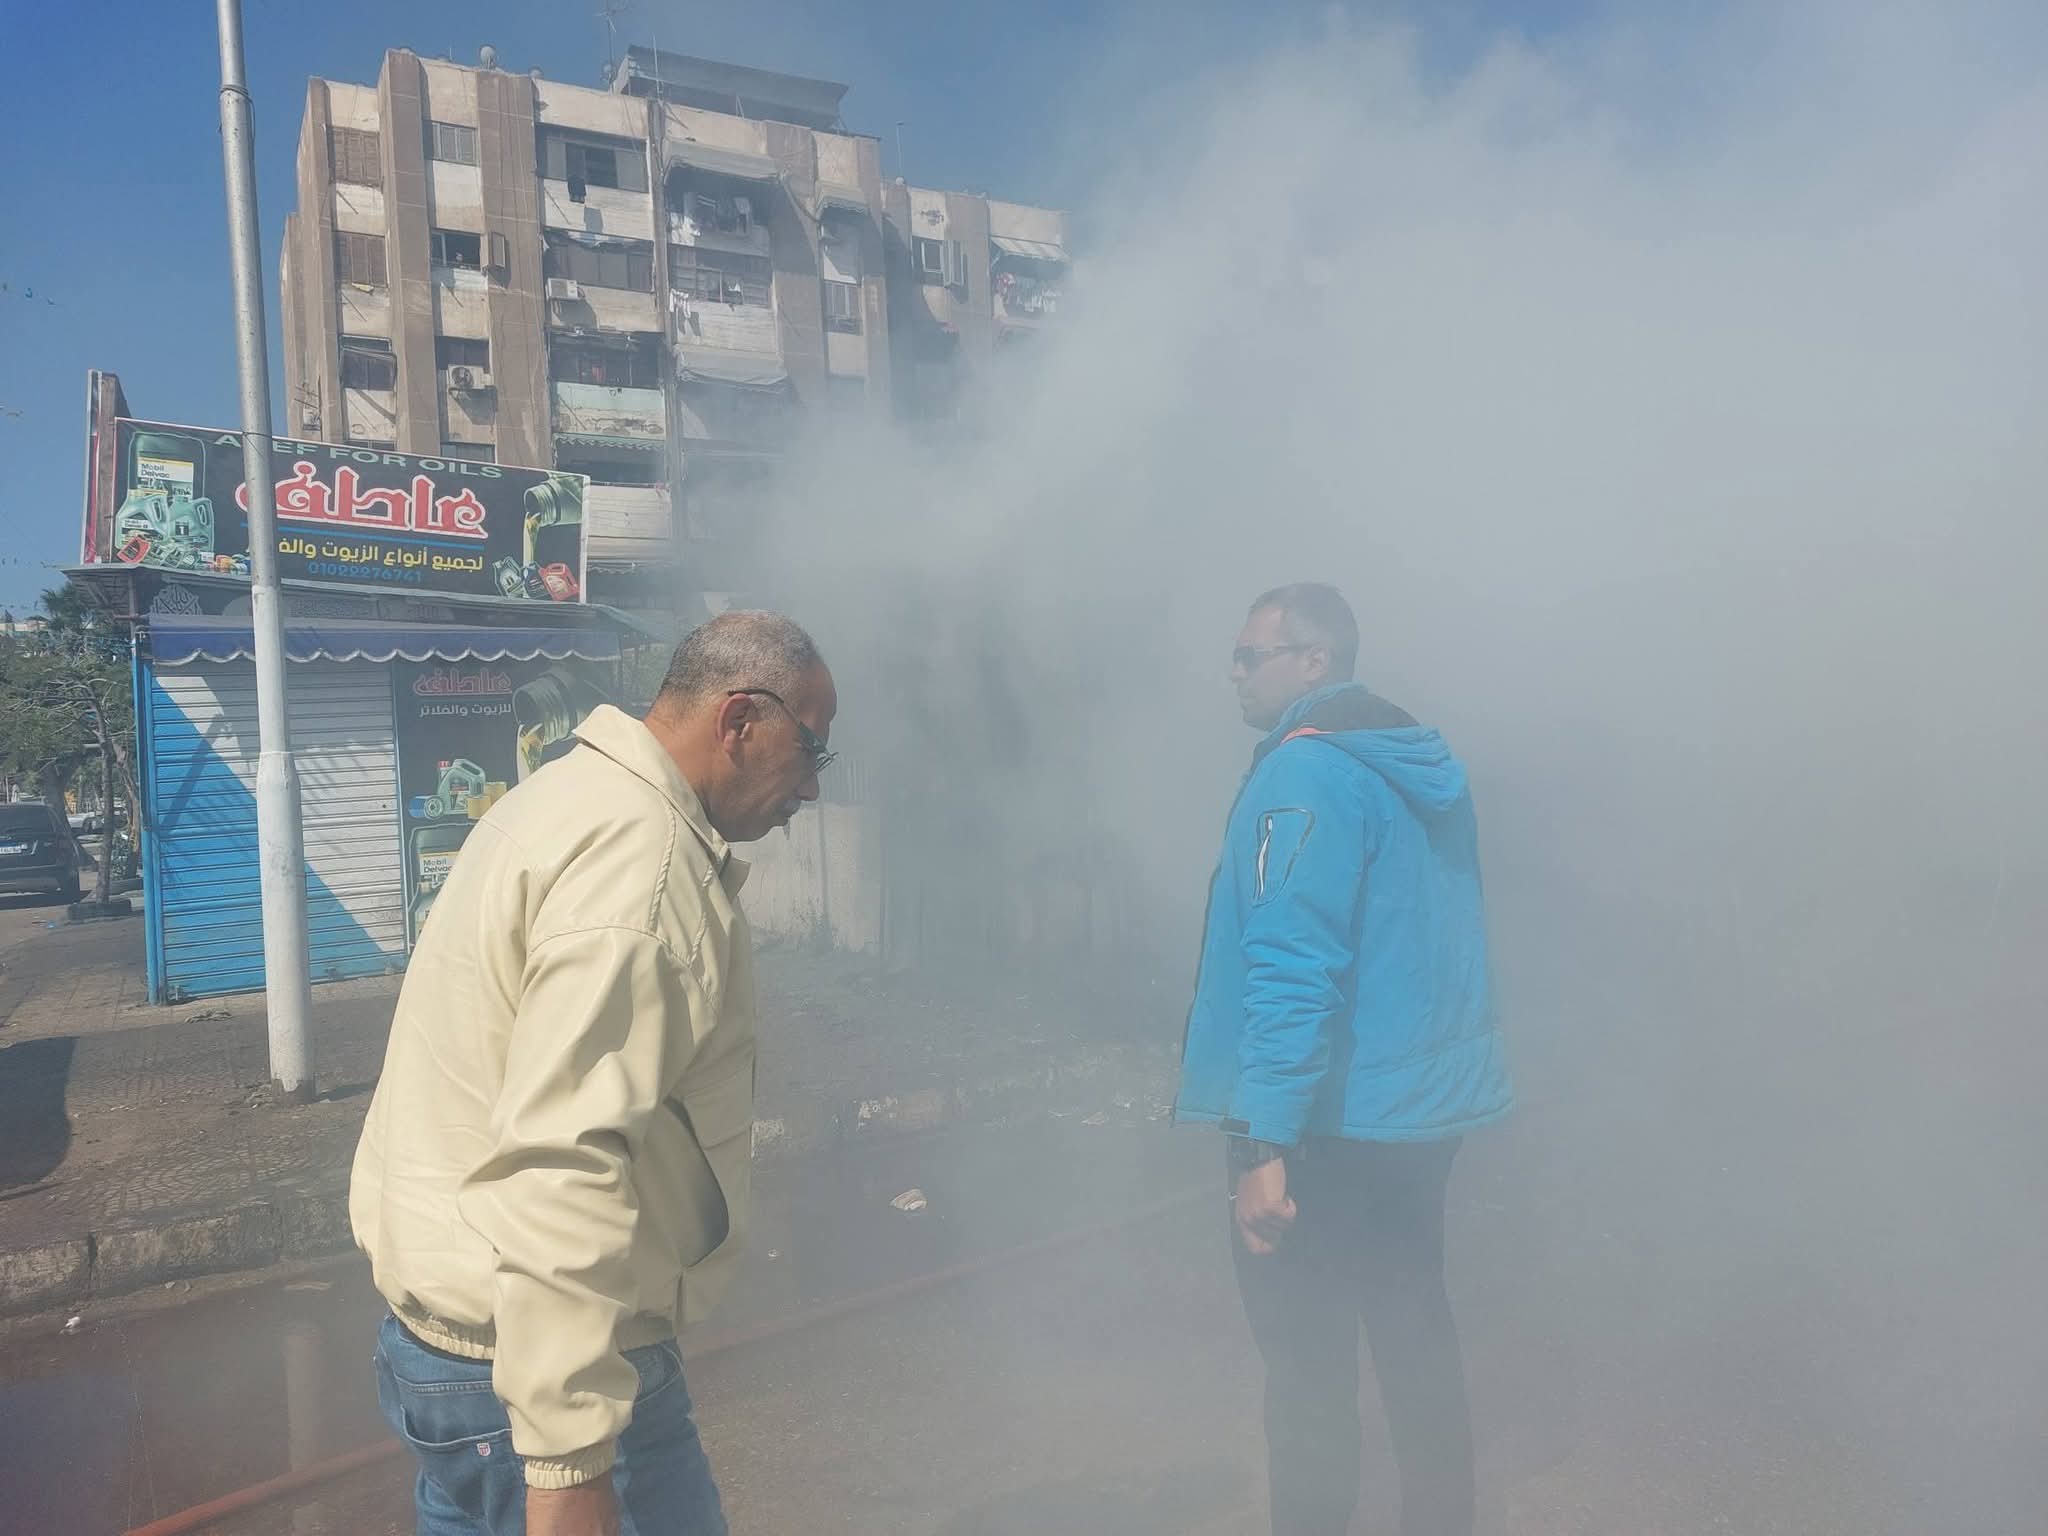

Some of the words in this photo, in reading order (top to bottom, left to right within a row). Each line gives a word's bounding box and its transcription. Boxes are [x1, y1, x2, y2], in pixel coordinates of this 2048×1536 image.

[214, 434, 319, 455] AEF
[329, 447, 408, 468] FOR
[418, 458, 503, 479] OILS
[141, 463, 165, 471] Mobil
[141, 470, 170, 478] Delvac
[235, 460, 489, 539] عاطف
[322, 541, 379, 563] الزيوت
[383, 546, 428, 567] أنواع
[432, 554, 484, 571] لجميع
[412, 667, 513, 696] عاطف
[418, 703, 468, 718] والفلاتر
[472, 703, 512, 716] للزيوت
[423, 858, 447, 866] Mobil
